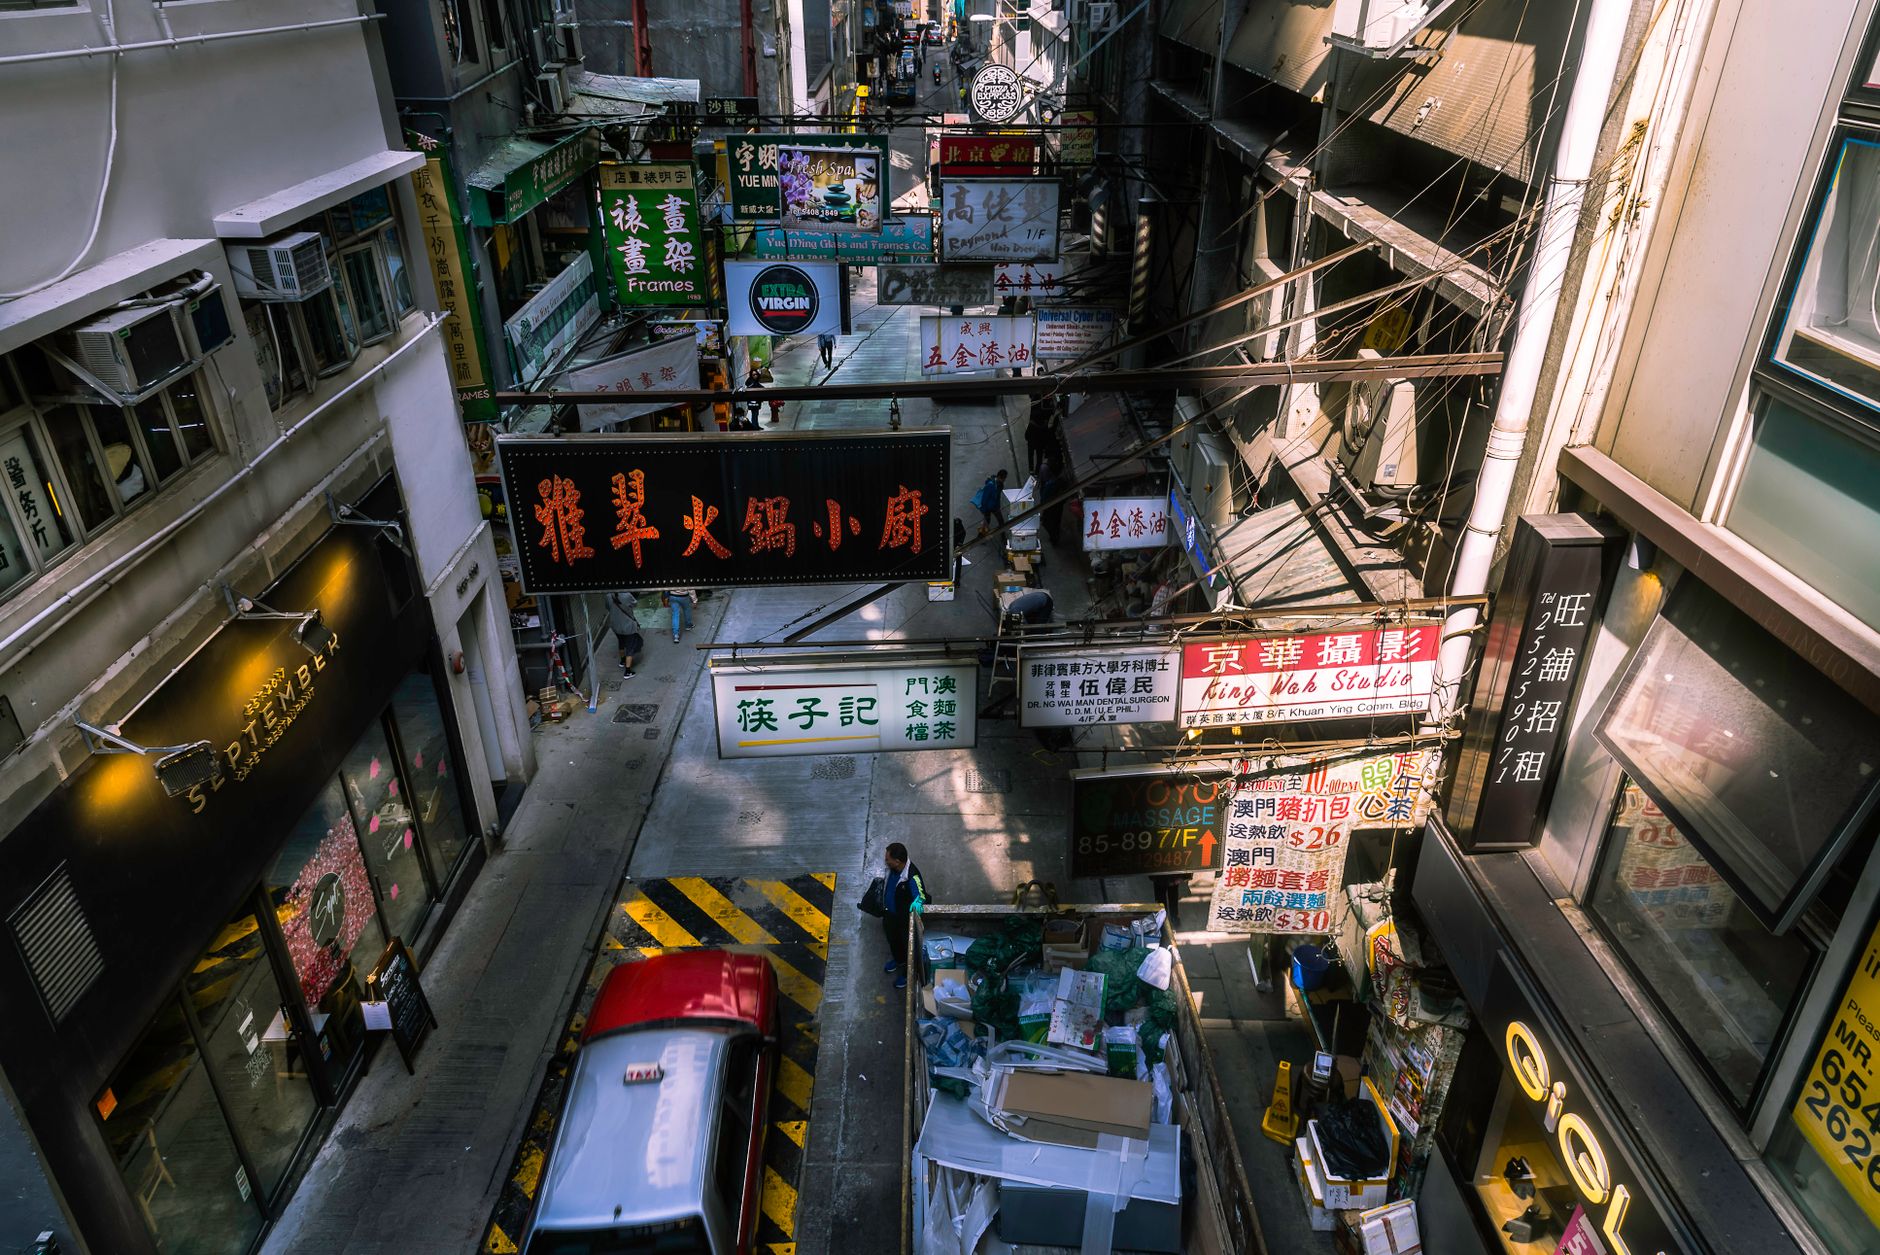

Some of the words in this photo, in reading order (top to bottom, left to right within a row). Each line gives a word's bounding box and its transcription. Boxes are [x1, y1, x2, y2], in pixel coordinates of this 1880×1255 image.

[707, 100, 738, 114] 沙龍
[738, 174, 761, 188] YUE
[787, 159, 824, 176] Fresh
[827, 161, 852, 181] Spa
[801, 208, 820, 217] 5408
[821, 209, 839, 217] 1849
[767, 238, 786, 248] Yue
[789, 238, 817, 249] Ming
[820, 238, 847, 249] Glass
[850, 239, 868, 249] and
[871, 240, 910, 250] Frames
[912, 240, 930, 251] Co.
[948, 225, 1009, 252] Raymond
[1026, 229, 1046, 241] 1/F
[628, 278, 695, 293] Frames
[761, 284, 806, 297] EXTRA
[757, 297, 810, 310] VIRGIN
[1038, 310, 1072, 322] Universal
[1073, 311, 1094, 323] Cyber
[923, 340, 1030, 369] 五金漆油
[1086, 508, 1167, 539] 五金漆油
[1540, 592, 1557, 604] Tel
[1201, 629, 1423, 675] 京華攝影
[1031, 658, 1170, 678] 菲律賓東方大學牙科博士
[1078, 676, 1153, 698] 伍偉民
[1202, 681, 1257, 707] King
[1270, 673, 1318, 696] Wah
[1331, 666, 1413, 691] Studio
[1495, 611, 1552, 784] 25259071
[1028, 701, 1041, 709] DR.
[1043, 700, 1056, 708] NG
[1057, 699, 1074, 707] WAI
[1076, 698, 1095, 707] MAN
[1096, 697, 1129, 706] DENTAL
[1129, 695, 1170, 705] SURGEON
[1186, 709, 1264, 725] 群英商業大廈
[1267, 708, 1285, 719] 8/F
[1289, 706, 1324, 717] Khuan
[1329, 703, 1353, 716] Ying
[1357, 701, 1394, 713] Comm.
[1399, 699, 1423, 711] Bldg
[187, 632, 341, 815] SEPTEMBER
[736, 696, 880, 733] 筷子記
[1078, 715, 1095, 723] 4/F
[1288, 776, 1303, 791] 至
[1303, 755, 1358, 795] 10:00PM
[1125, 779, 1219, 807] YOYO
[1113, 806, 1216, 828] MASSAGE
[1078, 830, 1152, 854] 85-89
[1157, 828, 1199, 848] 7/F
[1228, 822, 1287, 840] 送熱飲
[1289, 822, 1342, 849] $26
[1226, 847, 1275, 867] 澳門
[1225, 867, 1329, 892] 撈麵套餐
[1217, 905, 1273, 921] 送熱飲
[1275, 910, 1330, 931] $30
[1834, 1019, 1875, 1077] MR.
[628, 1069, 657, 1081] TAXI
